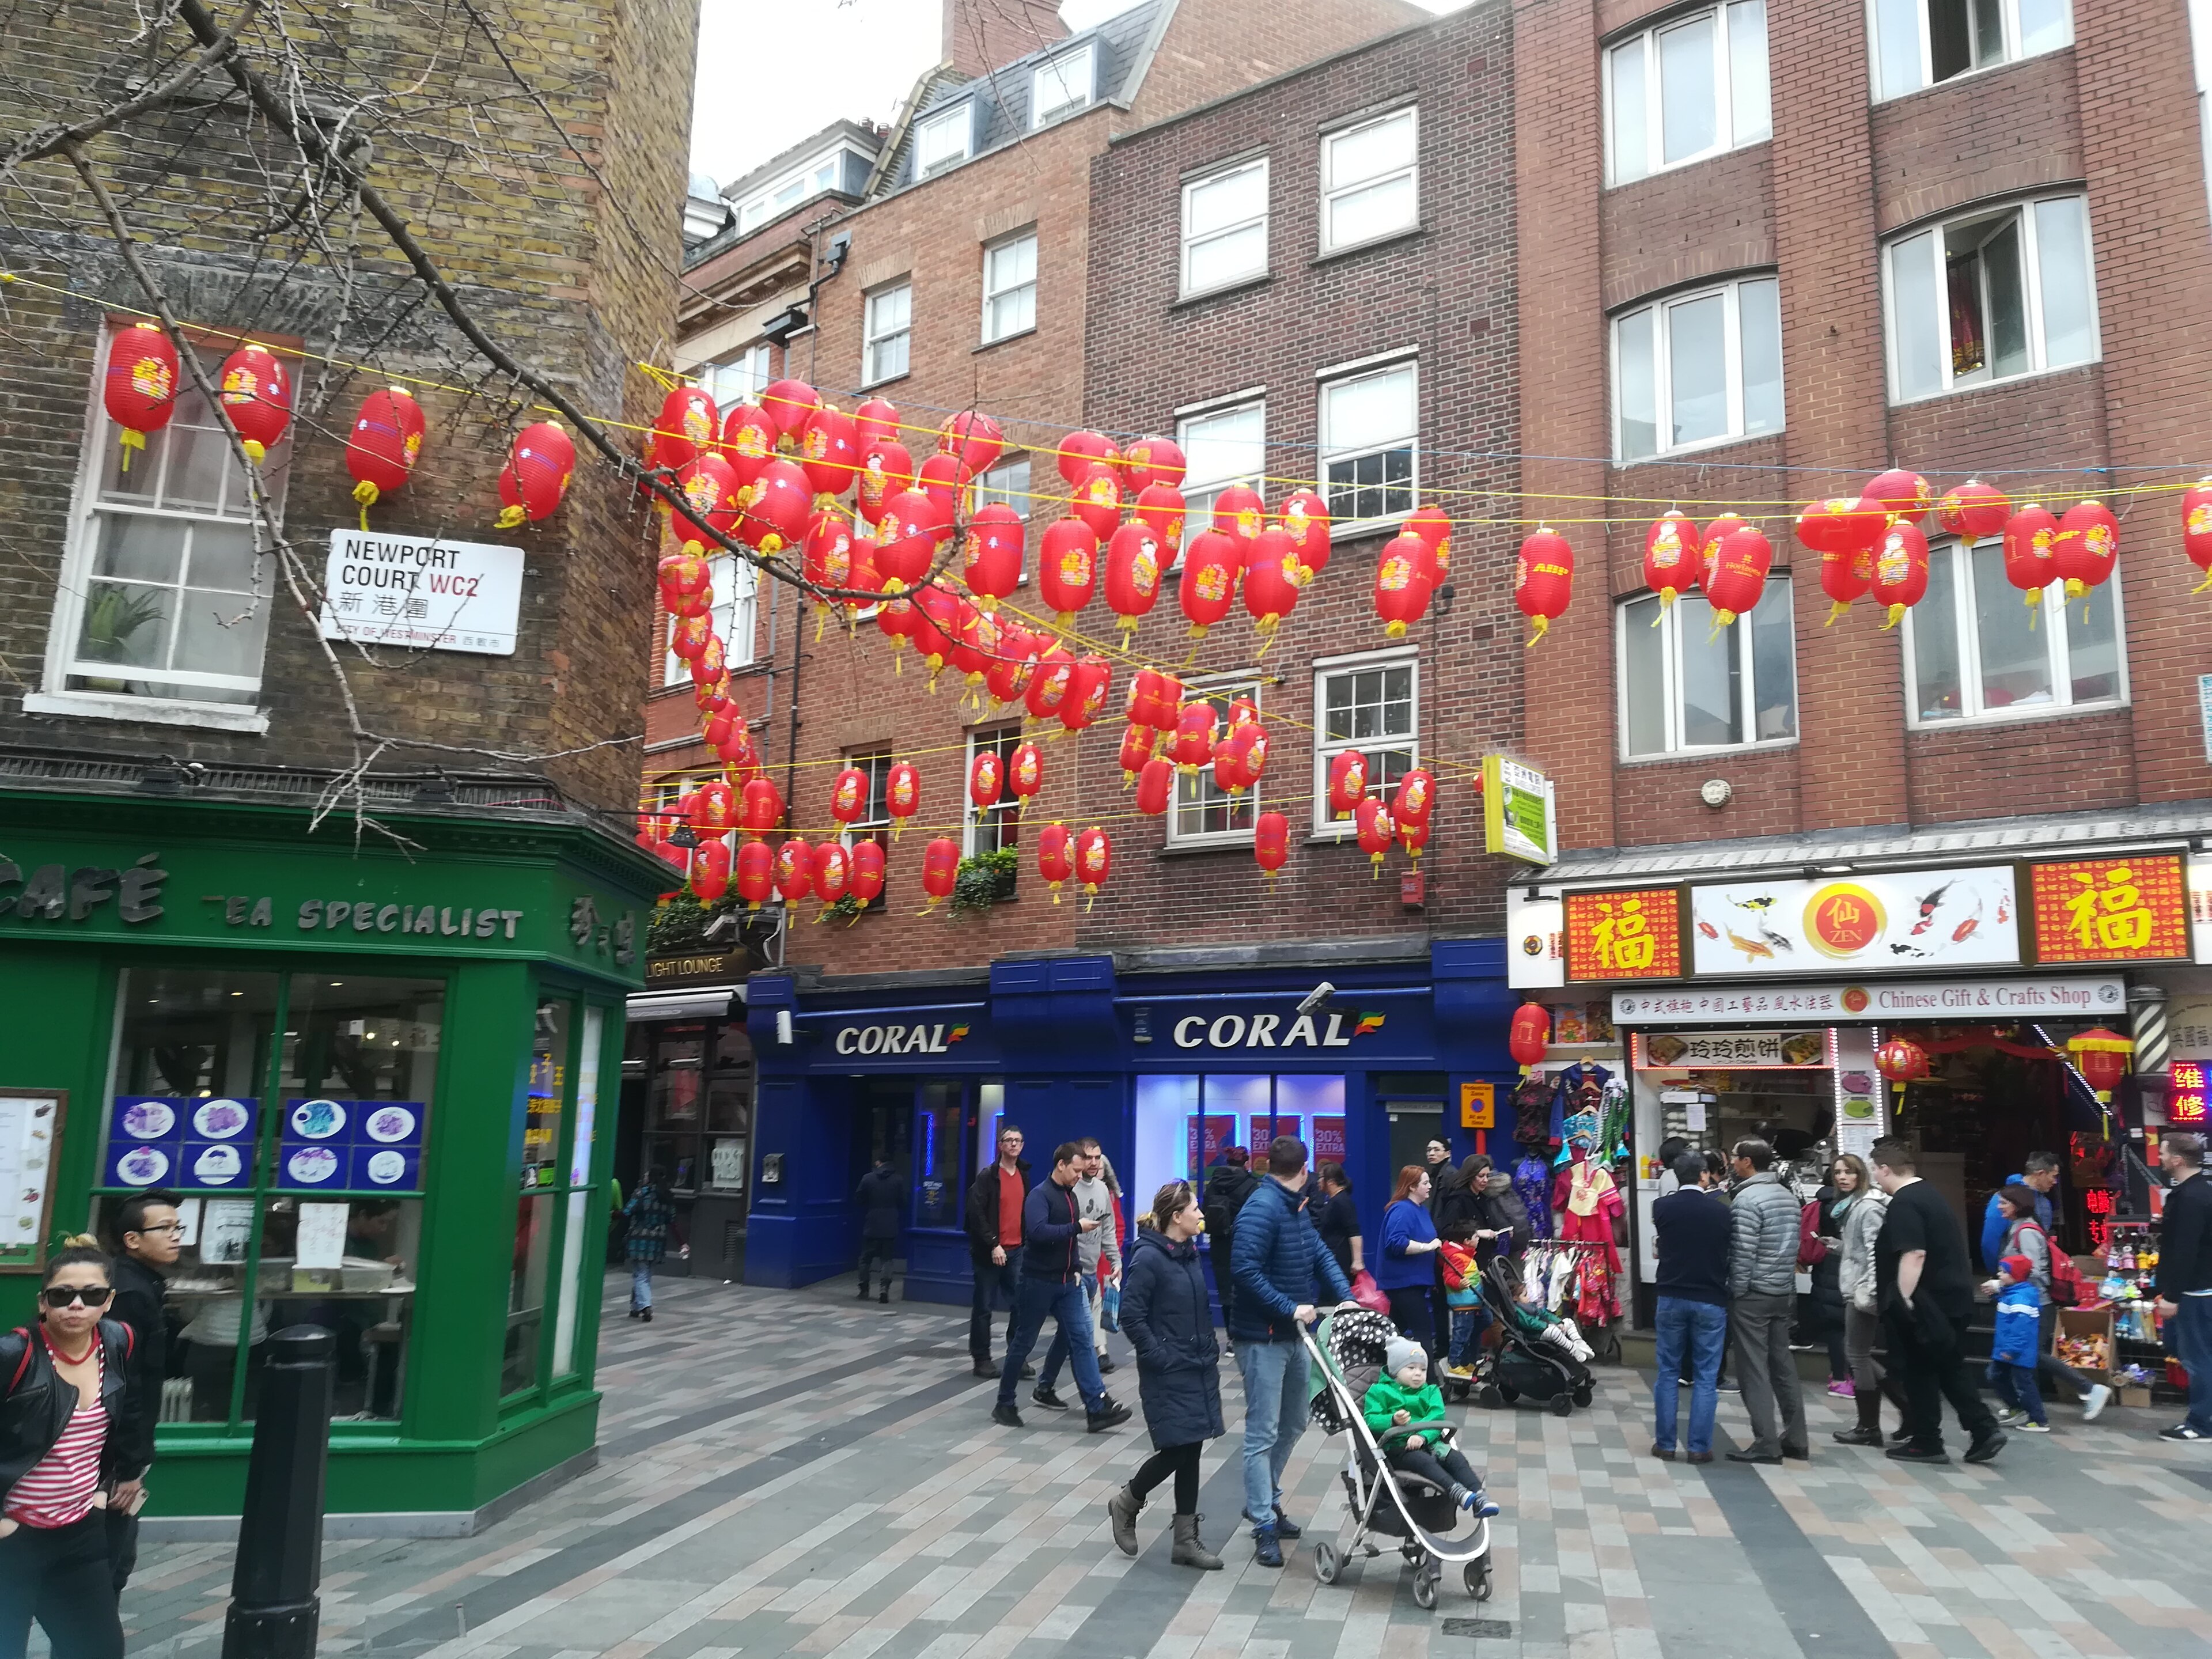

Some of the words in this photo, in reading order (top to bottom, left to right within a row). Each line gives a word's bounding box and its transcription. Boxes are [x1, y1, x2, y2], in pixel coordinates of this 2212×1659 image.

[346, 539, 460, 569] NEWPORT
[342, 565, 420, 593] COURT
[429, 573, 479, 597] WC2
[363, 627, 377, 636] OF
[380, 628, 457, 644] WESTMINSTER
[297, 899, 524, 939] SPECIALIST
[1826, 897, 1861, 929] 仙
[2065, 867, 2153, 950] 福
[1590, 899, 1655, 969] 福
[1830, 929, 1862, 943] ZEN
[645, 960, 676, 978] LIGHT
[677, 957, 724, 975] LOUNGE
[1878, 990, 1937, 1009] Chinese
[1941, 987, 1972, 1007] Gift
[1978, 988, 1990, 1006] &
[1996, 986, 2046, 1006] Crafts
[2050, 986, 2092, 1009] Shop
[835, 1024, 948, 1055] CORAL
[1173, 1013, 1350, 1048] CORAL
[1690, 1038, 1779, 1059] 玲玲煎饼
[2174, 1067, 2205, 1116] 维修
[1189, 1127, 1214, 1141] 3%
[1190, 1140, 1217, 1150] ERA
[1252, 1128, 1271, 1142] 30
[1315, 1142, 1346, 1153] EXTRA
